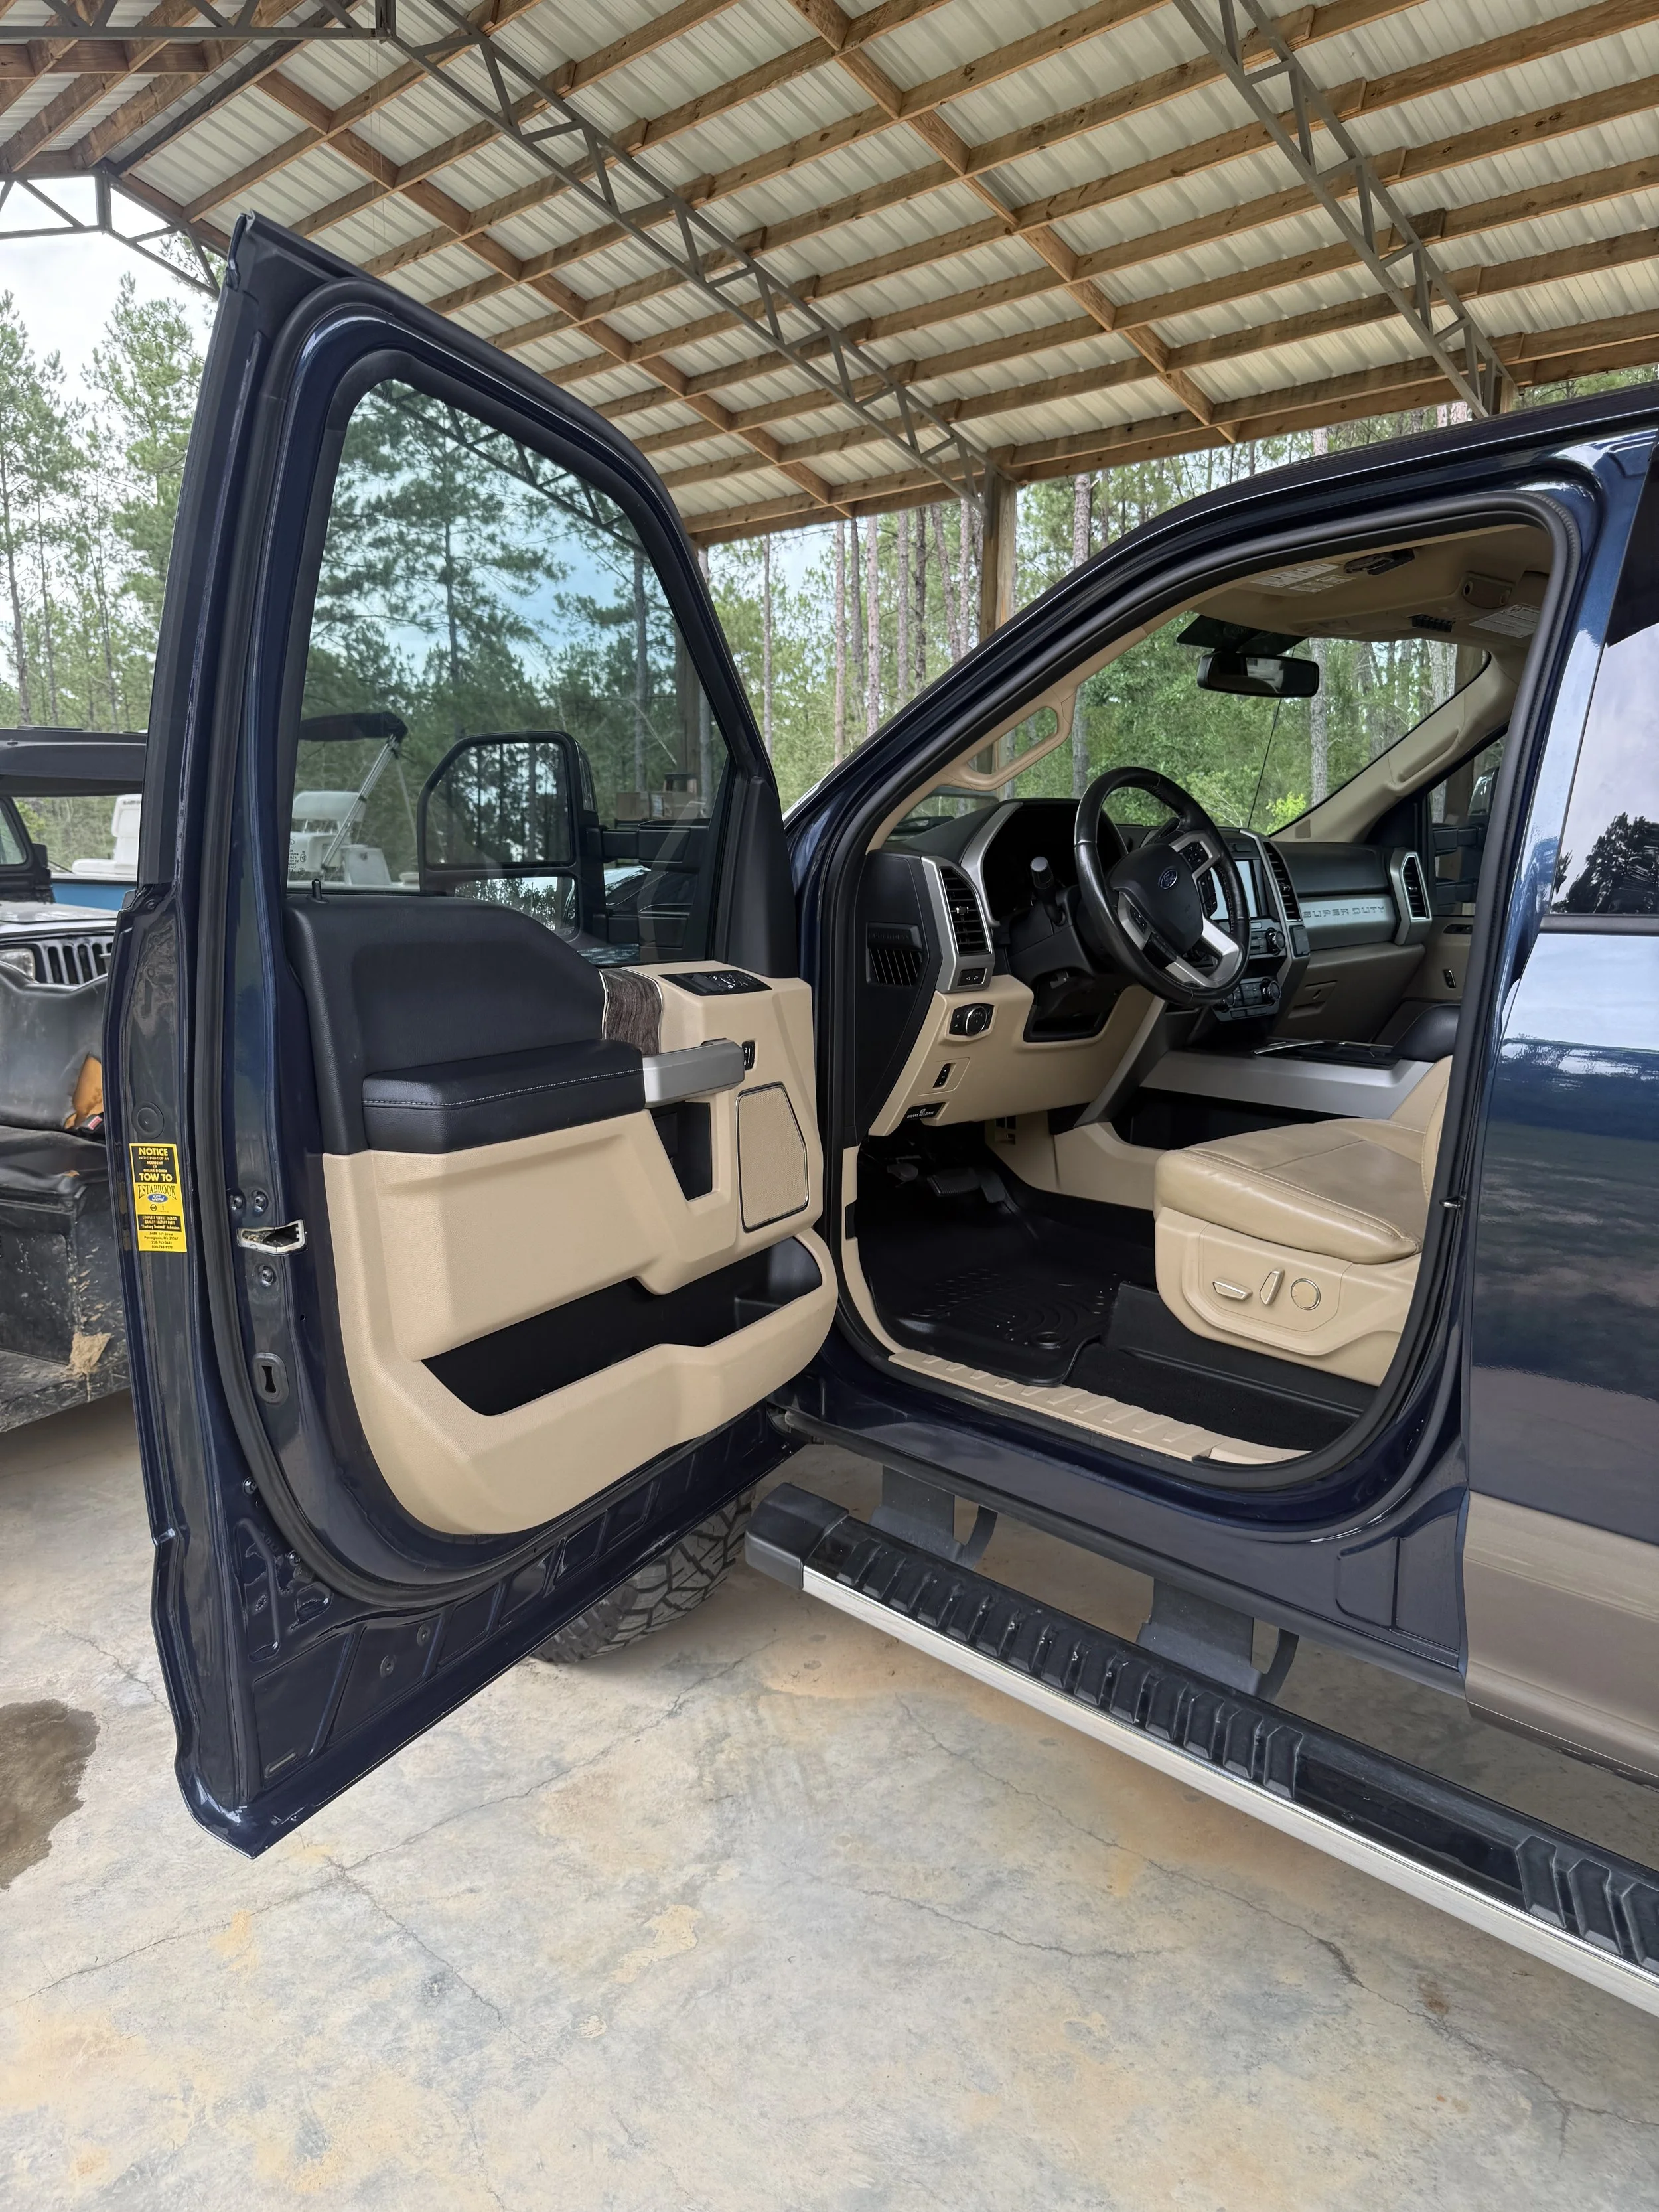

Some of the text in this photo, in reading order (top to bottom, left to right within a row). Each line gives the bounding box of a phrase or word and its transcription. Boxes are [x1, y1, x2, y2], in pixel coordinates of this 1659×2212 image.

[1303, 908, 1349, 919] SUPER
[139, 1147, 168, 1156] NOTICE
[139, 1173, 173, 1182] TOW TO
[138, 1185, 177, 1200] ESTABROOK
